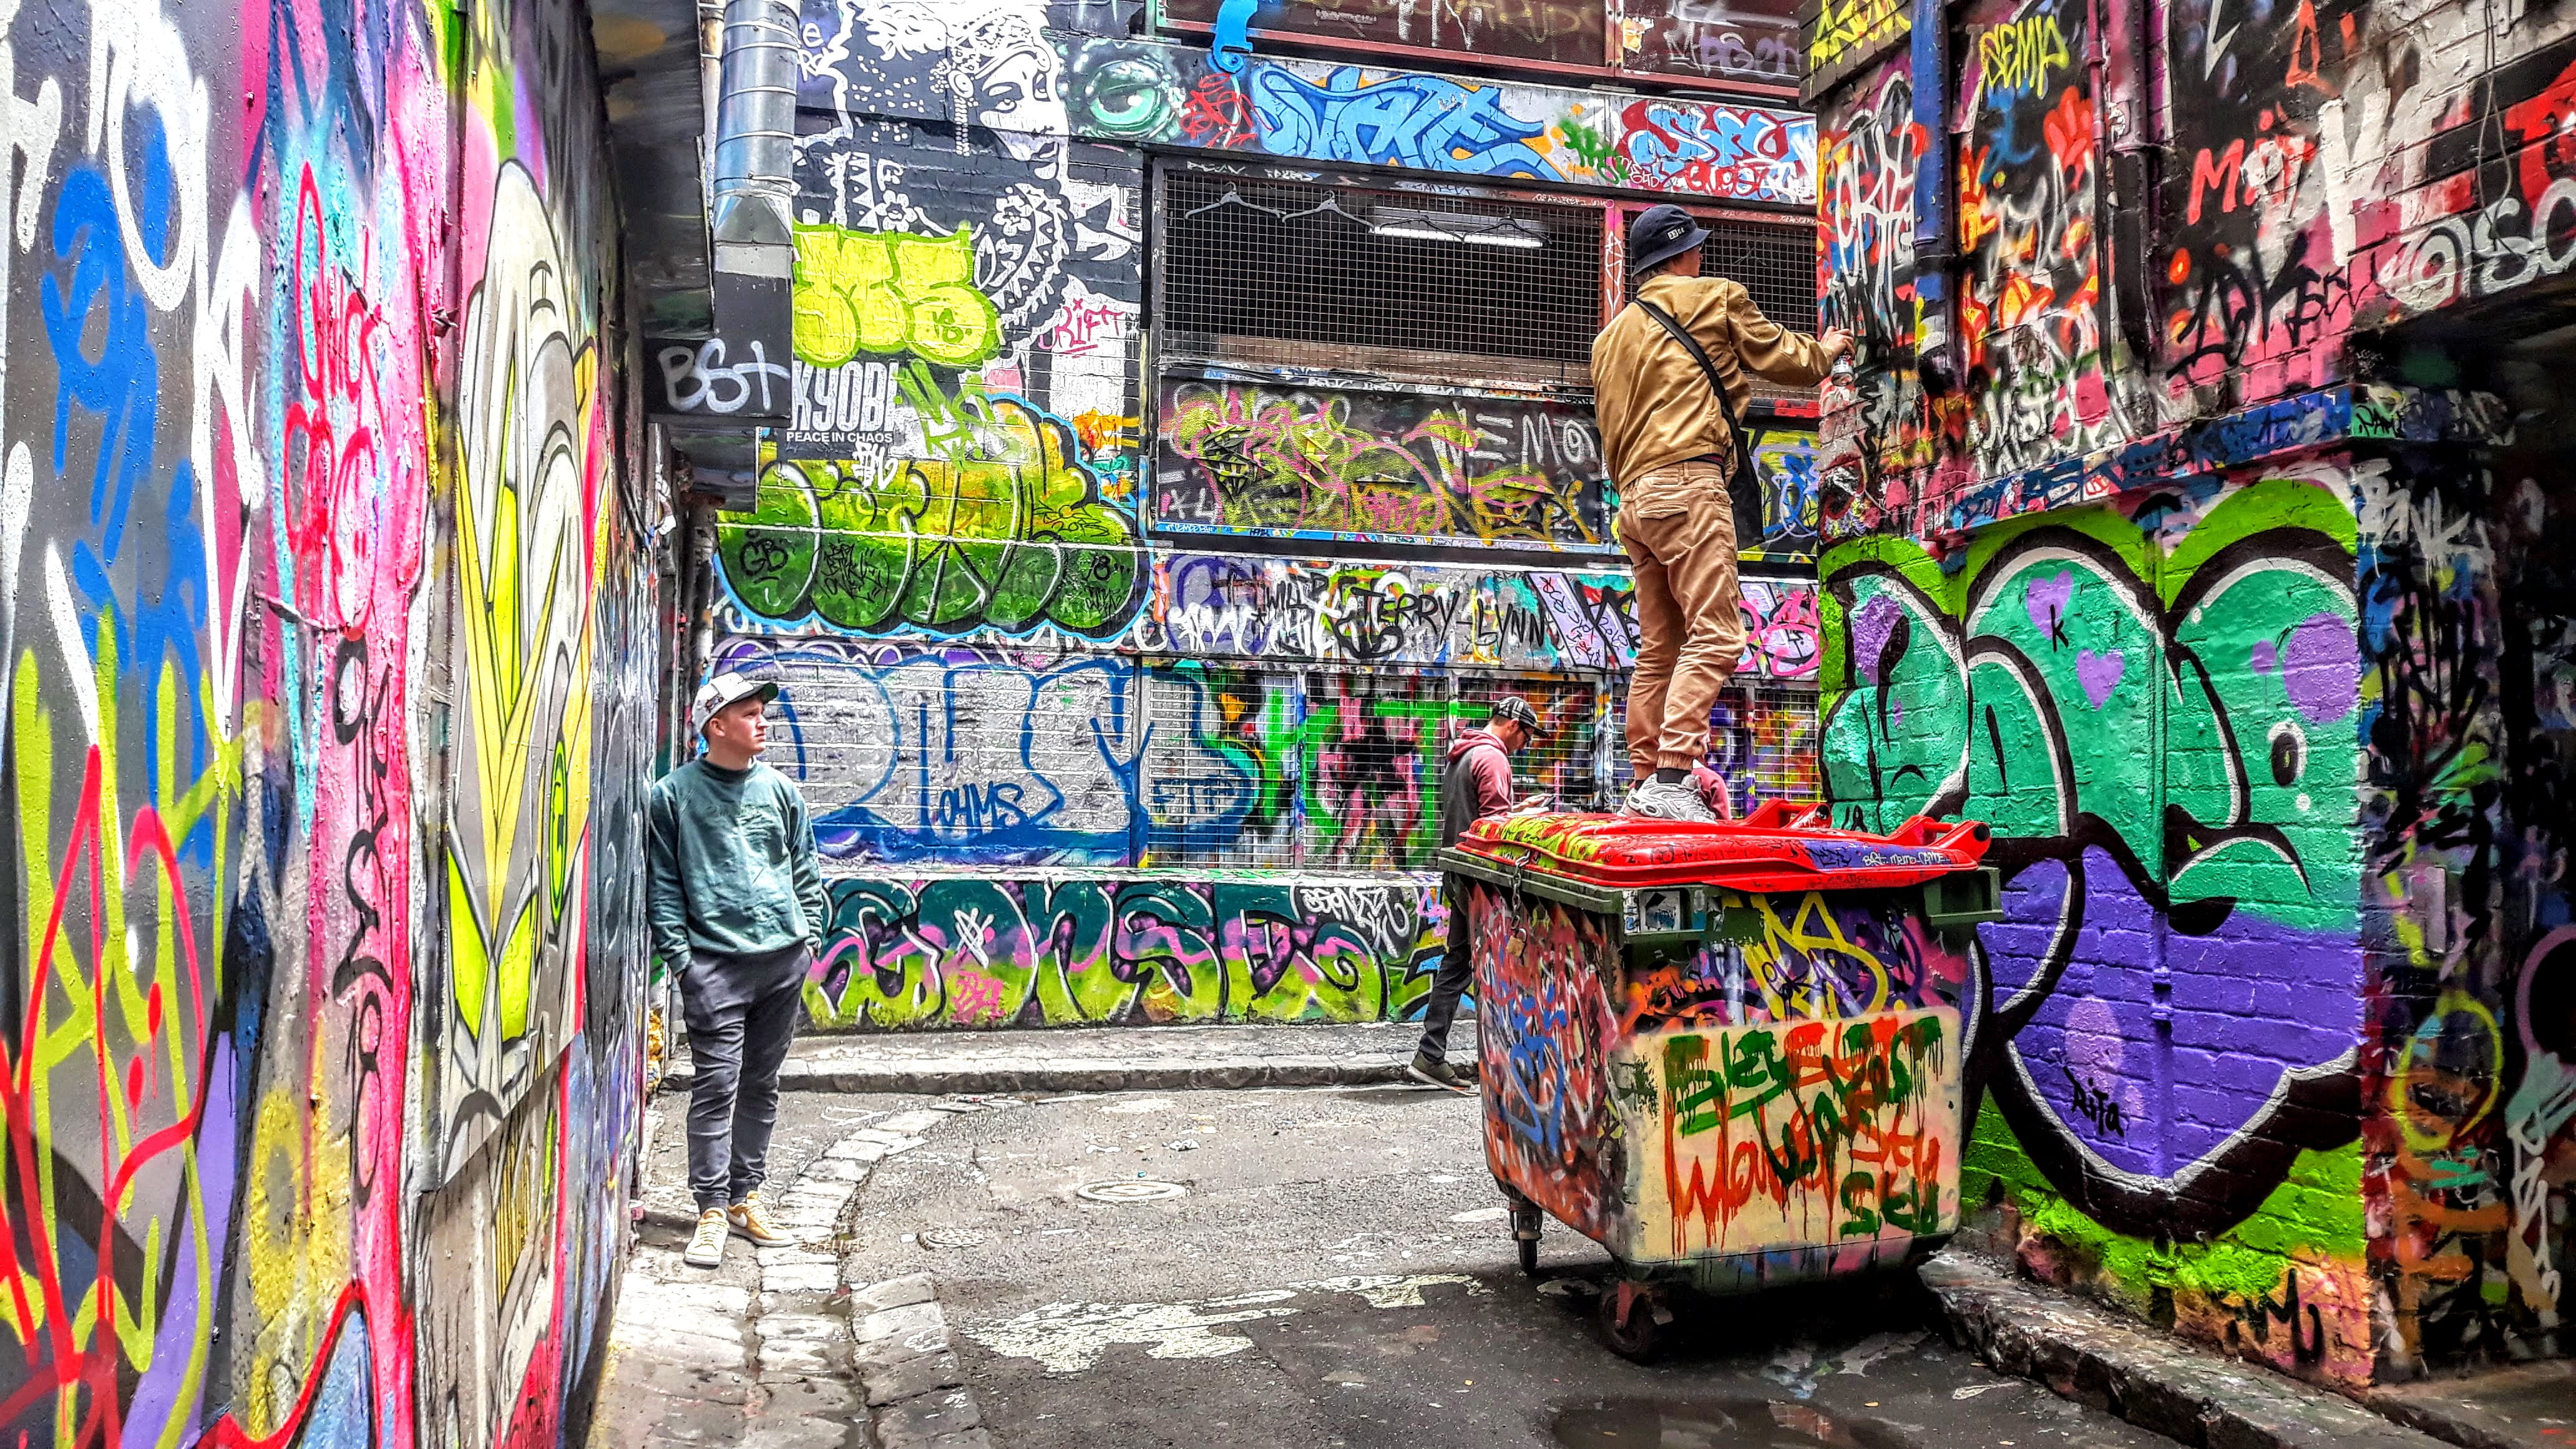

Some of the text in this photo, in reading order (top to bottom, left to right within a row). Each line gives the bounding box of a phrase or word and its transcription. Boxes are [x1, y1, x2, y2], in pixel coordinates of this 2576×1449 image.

[786, 432, 893, 444] PEACE IN CHAOS
[940, 781, 1027, 840] OHMS
